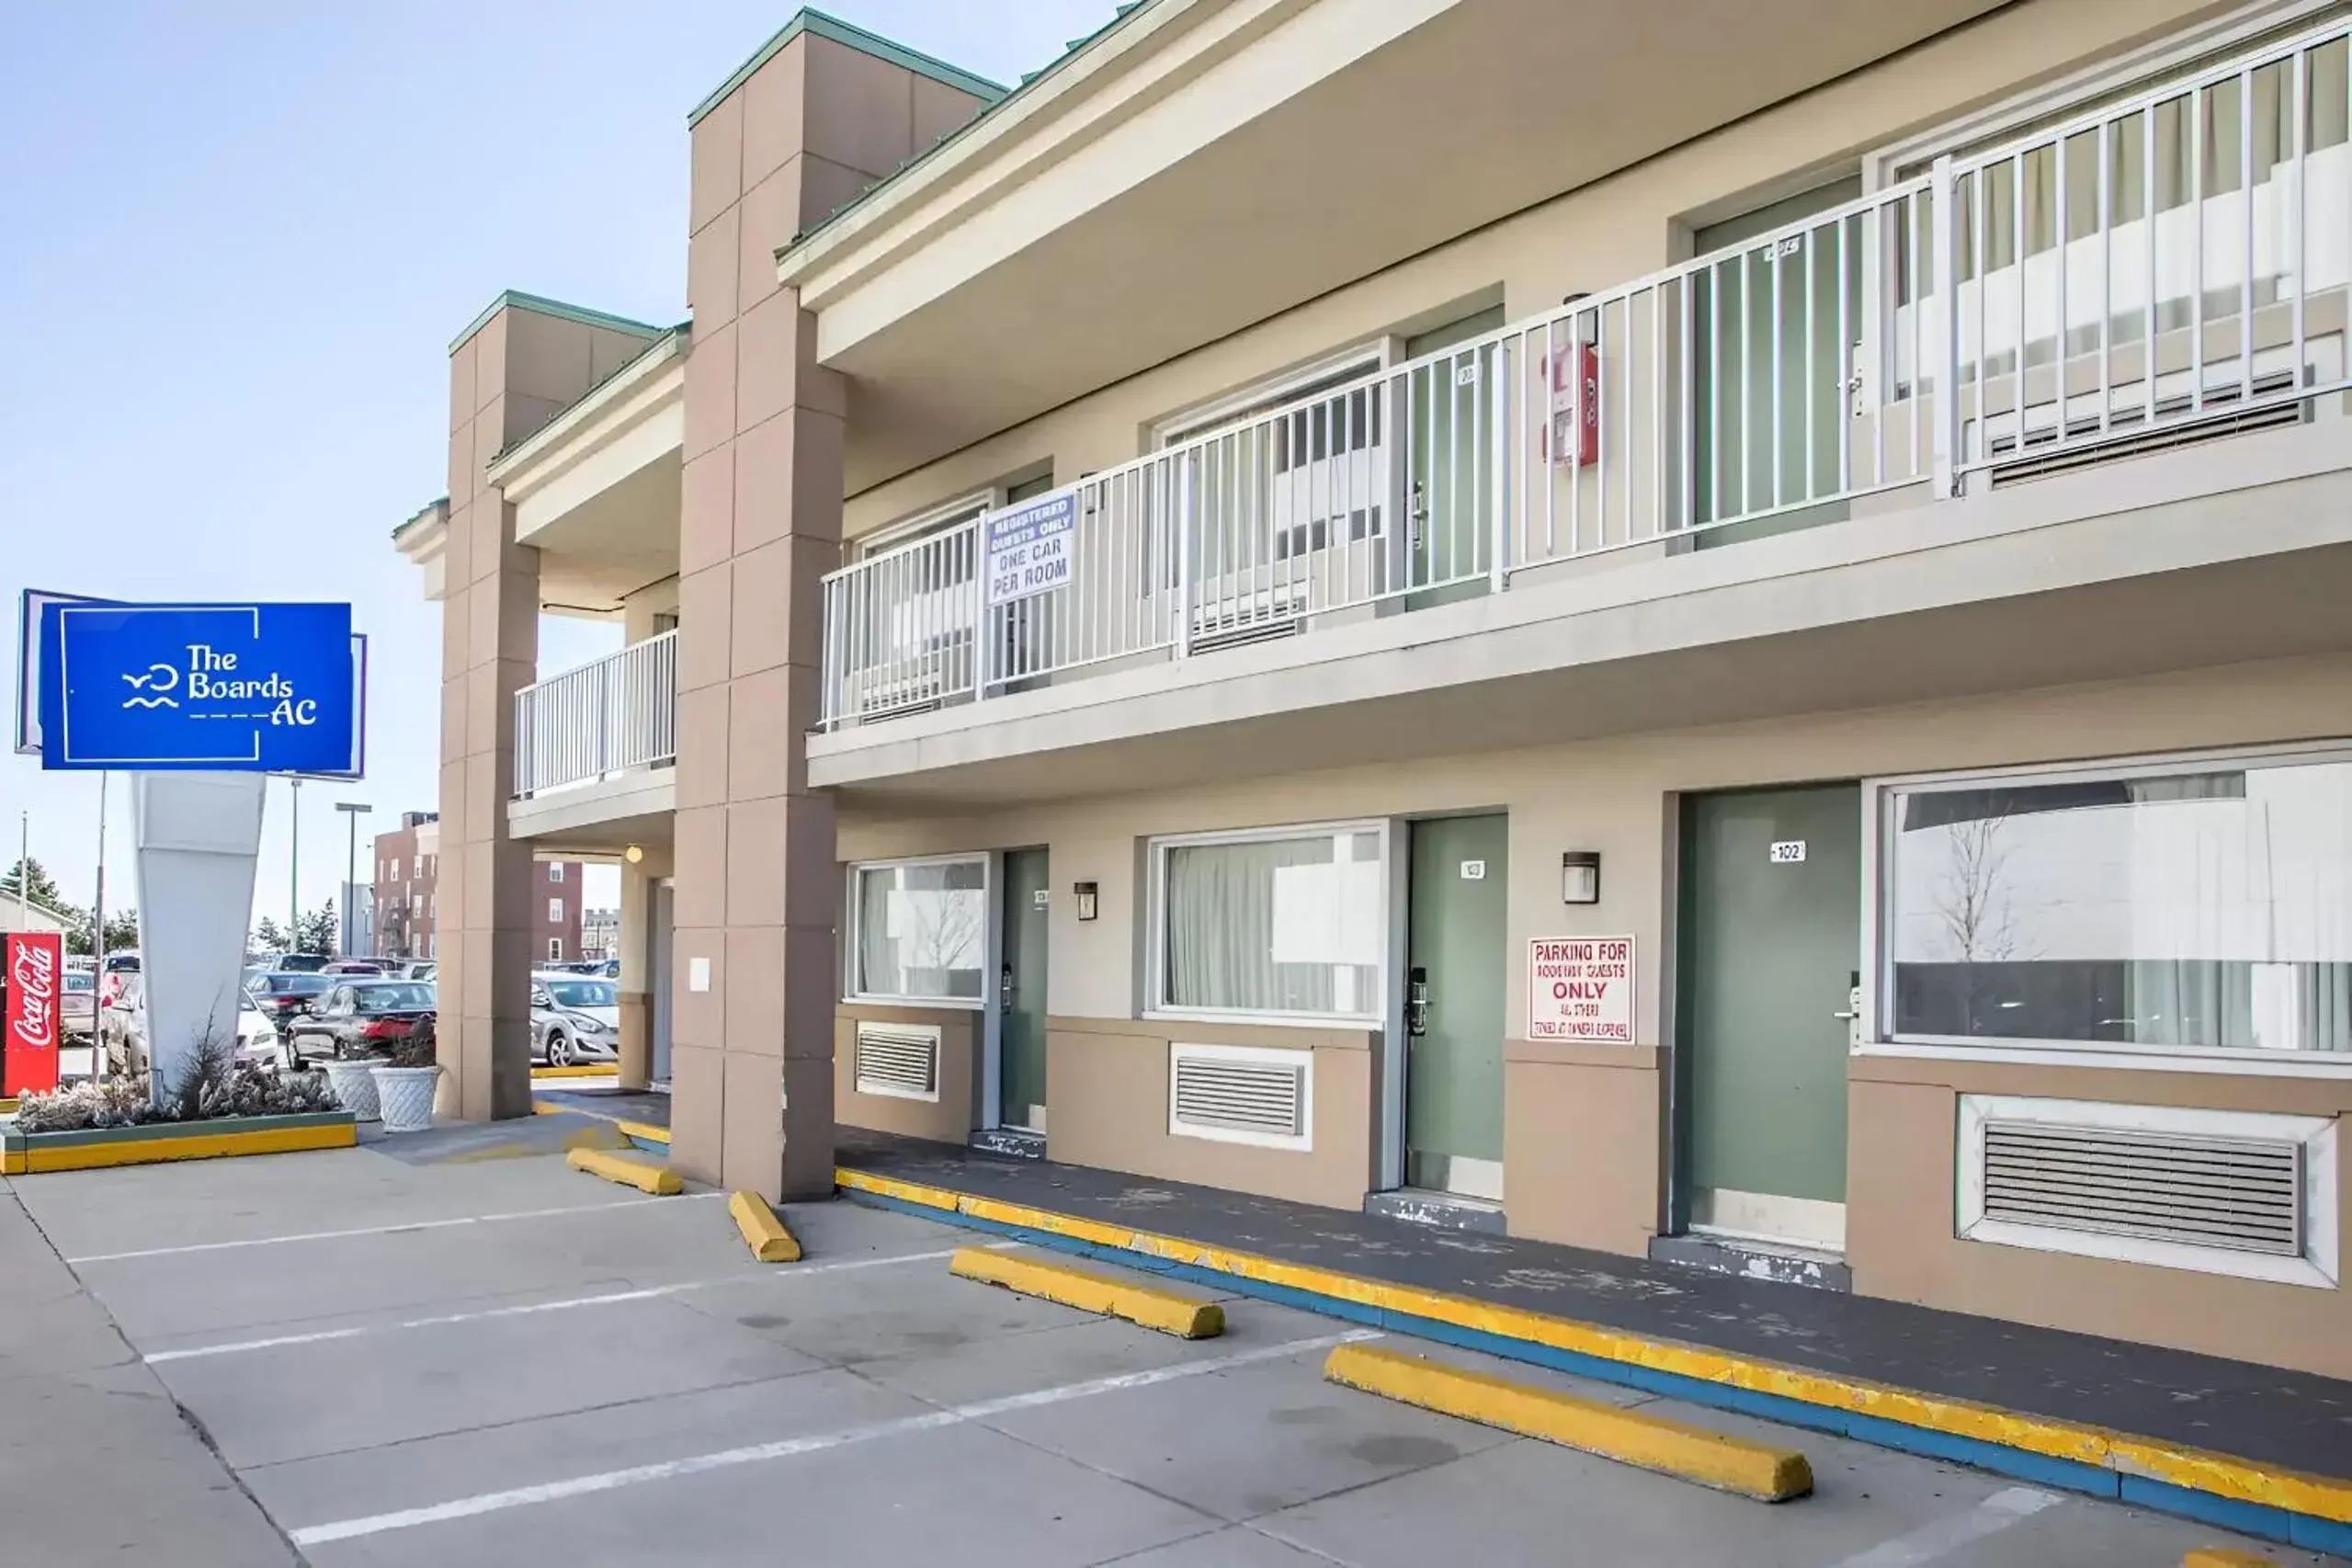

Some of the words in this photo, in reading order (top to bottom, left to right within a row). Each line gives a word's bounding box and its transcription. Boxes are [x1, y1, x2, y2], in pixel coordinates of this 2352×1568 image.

[1040, 515, 1071, 536] ONLY
[1000, 550, 1026, 572] ONE
[1032, 539, 1061, 561] CAR
[994, 573, 1018, 597] PER
[1025, 557, 1067, 586] ROOM
[186, 644, 237, 671] The
[188, 673, 293, 699] Boards
[270, 699, 316, 725] AC
[1536, 944, 1593, 961] PARKING
[1598, 943, 1627, 961] FOR
[1553, 982, 1607, 999] ONLY
